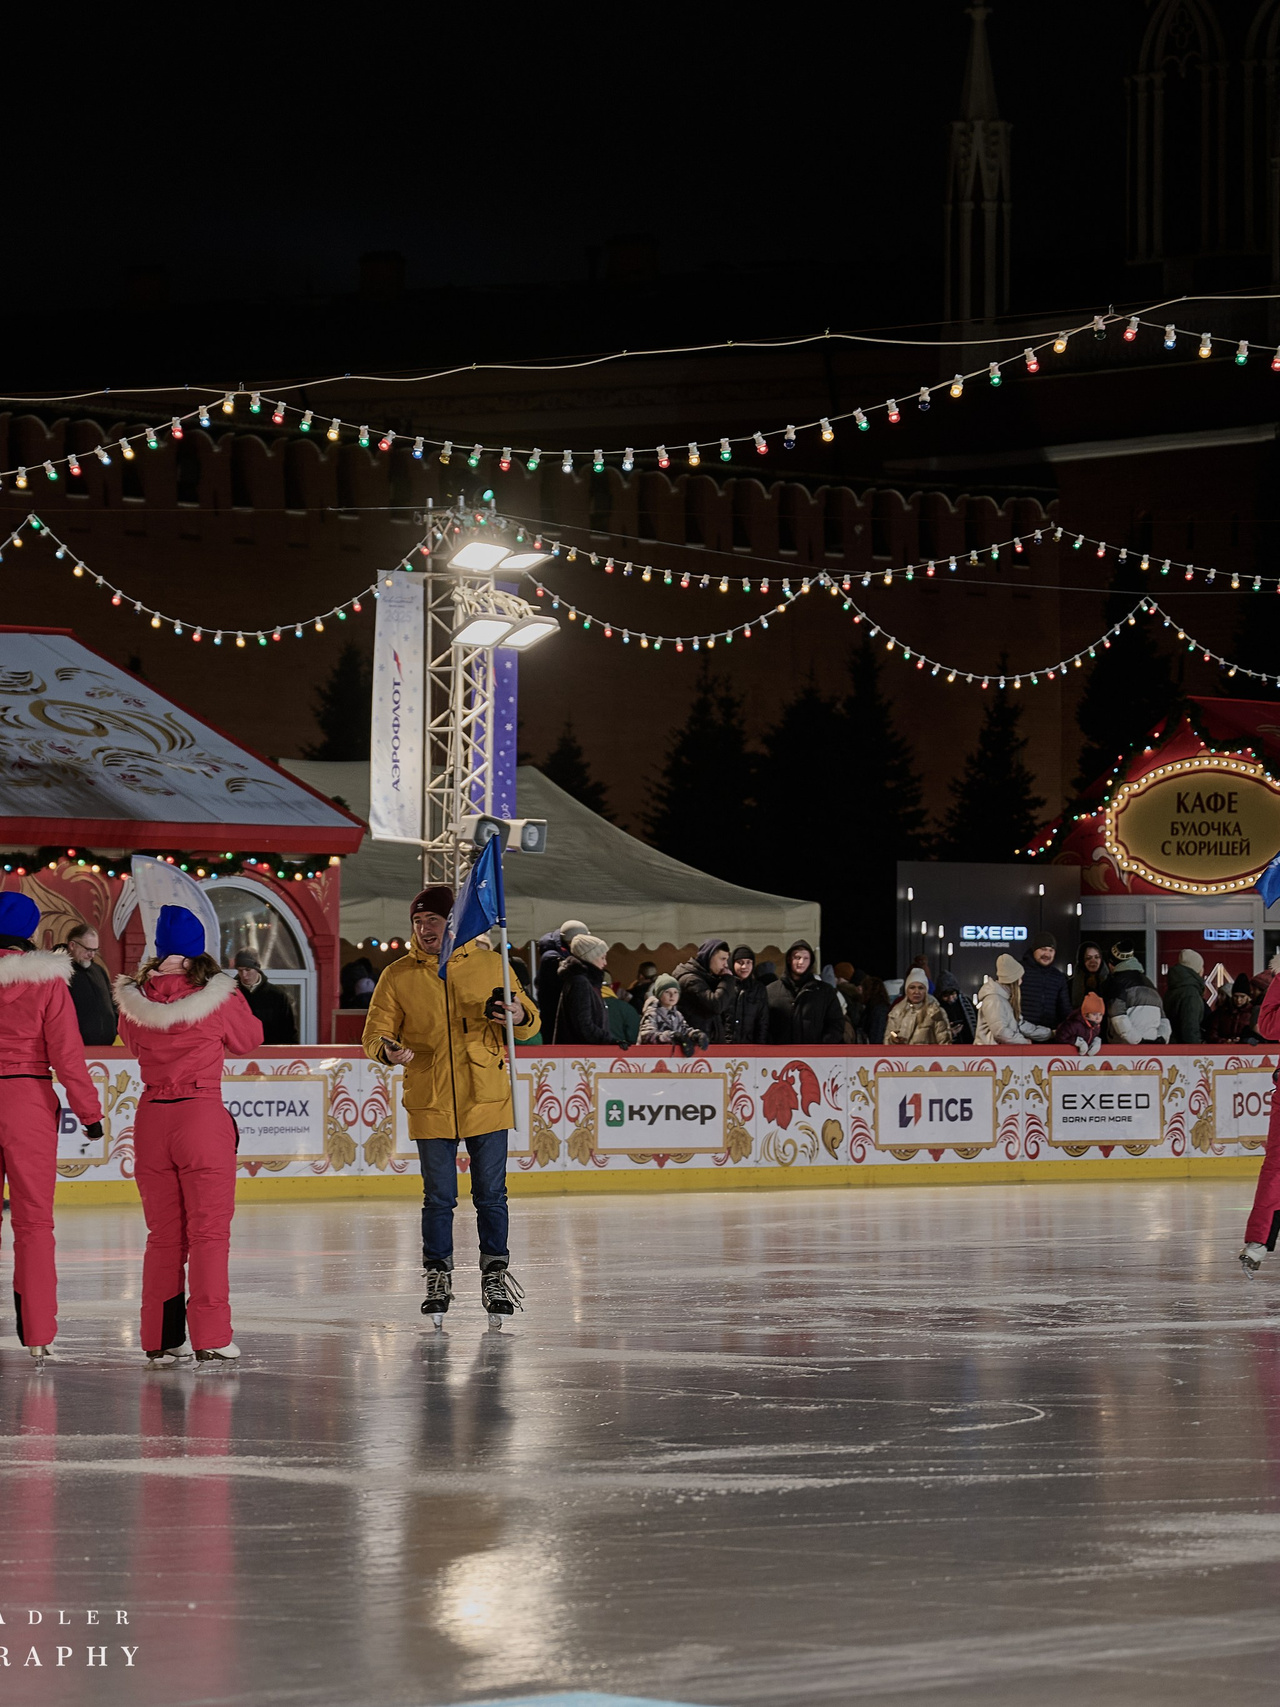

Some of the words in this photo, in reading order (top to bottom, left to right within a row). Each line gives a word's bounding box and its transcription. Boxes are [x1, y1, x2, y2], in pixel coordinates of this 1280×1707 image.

[391, 677, 402, 792] АЭРОФЛОТ
[1175, 791, 1238, 814] КАФЕ
[1170, 821, 1243, 836] БУЛОЧКА
[1161, 840, 1171, 856] С
[1176, 838, 1251, 856] КОРИЦЕЙ
[962, 925, 1028, 940] EXEED
[928, 1097, 974, 1122] ПСБ
[1061, 1093, 1150, 1110] EXEED
[1233, 1091, 1270, 1119] BOS
[628, 1103, 717, 1126] купер
[1061, 1115, 1087, 1123] BORN
[1088, 1115, 1107, 1123] FOR
[1108, 1114, 1133, 1123] MORE
[238, 1126, 256, 1135] ыть
[257, 1125, 310, 1137] уверенным
